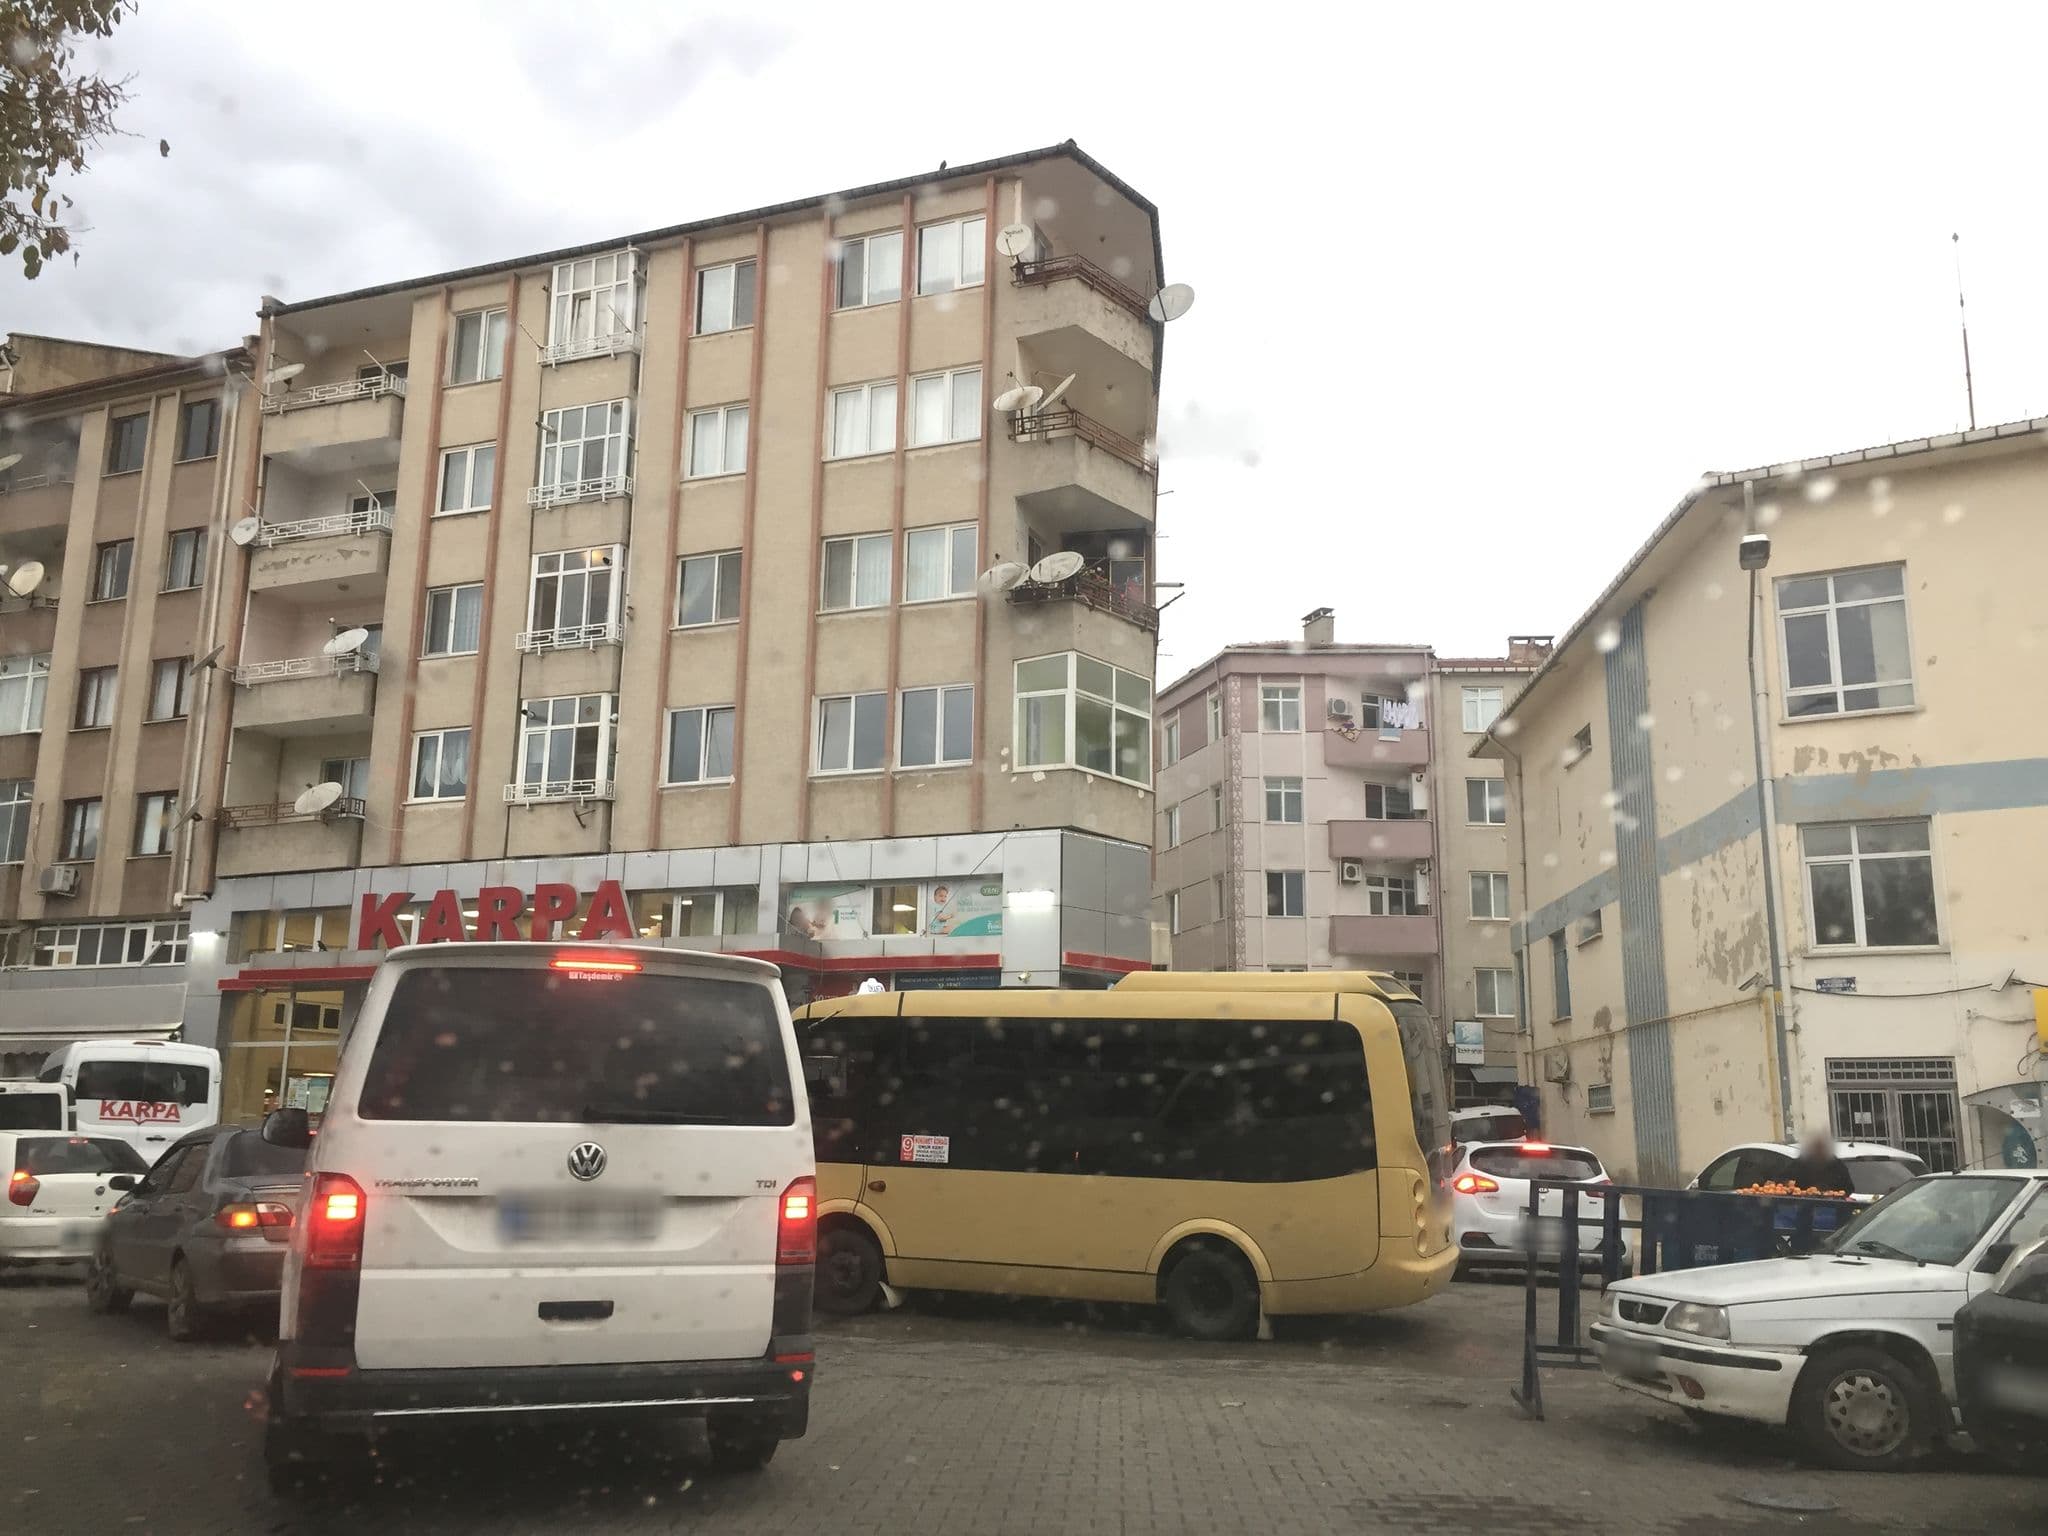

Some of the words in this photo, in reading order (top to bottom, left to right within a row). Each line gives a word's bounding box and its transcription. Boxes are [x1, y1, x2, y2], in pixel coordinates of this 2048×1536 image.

[357, 880, 634, 950] KARPA
[99, 1100, 181, 1119] KARPA
[904, 1139, 912, 1150] 9
[756, 1179, 777, 1189] TDI
